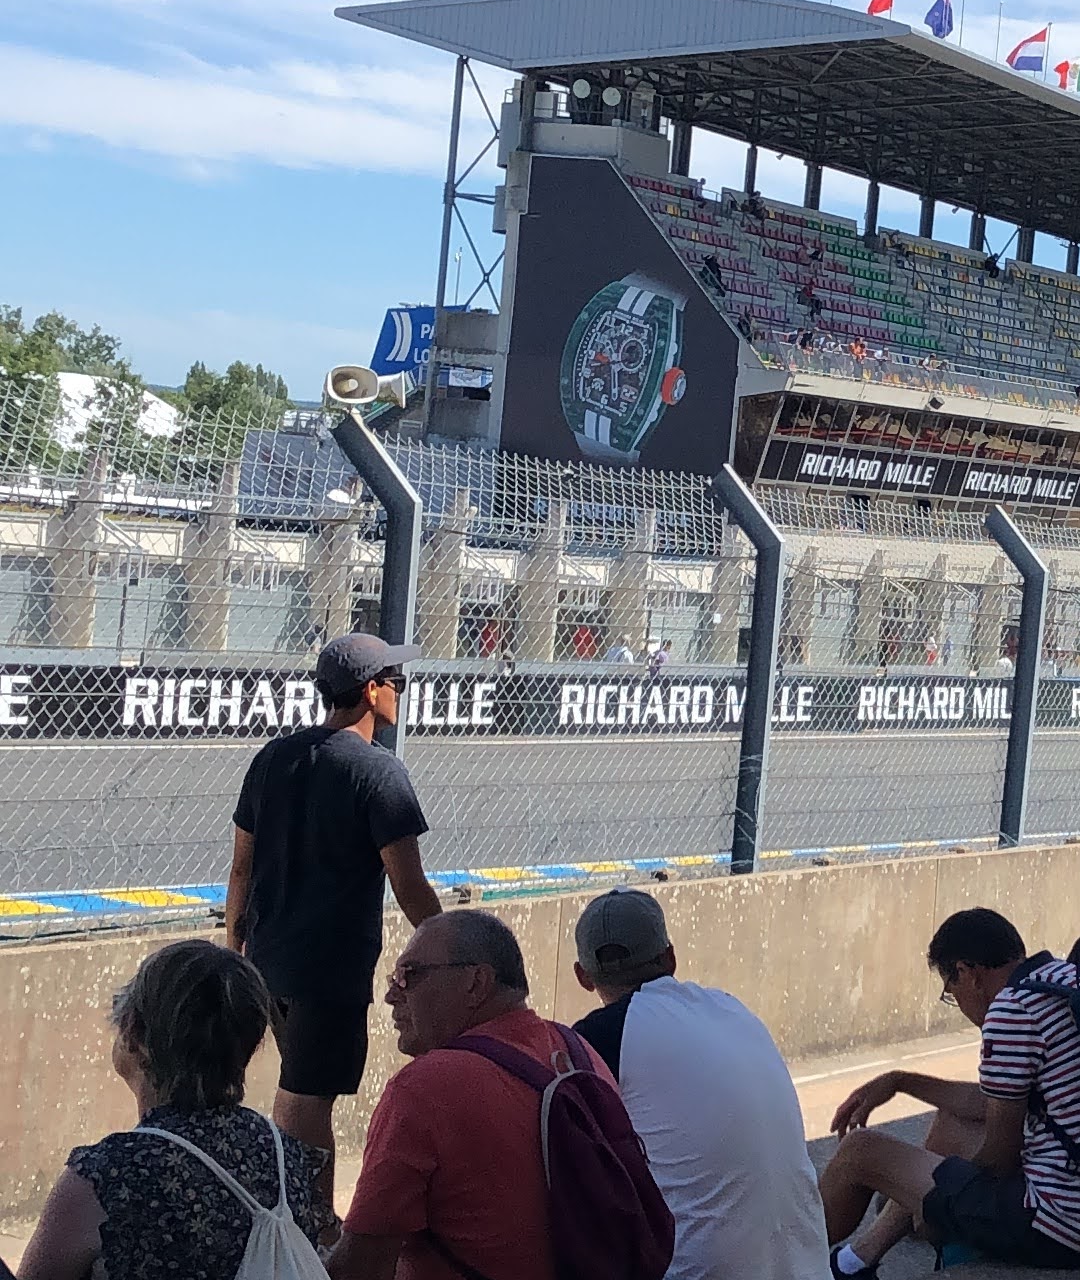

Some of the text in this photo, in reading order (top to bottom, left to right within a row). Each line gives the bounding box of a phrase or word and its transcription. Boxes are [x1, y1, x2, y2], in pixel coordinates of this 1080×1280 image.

[801, 453, 935, 487] RICHARD MILLE
[965, 470, 1076, 500] RICHARD MILLE
[408, 681, 496, 726] ILLE
[558, 683, 714, 725] RICHARD
[857, 685, 965, 721] RICHARD
